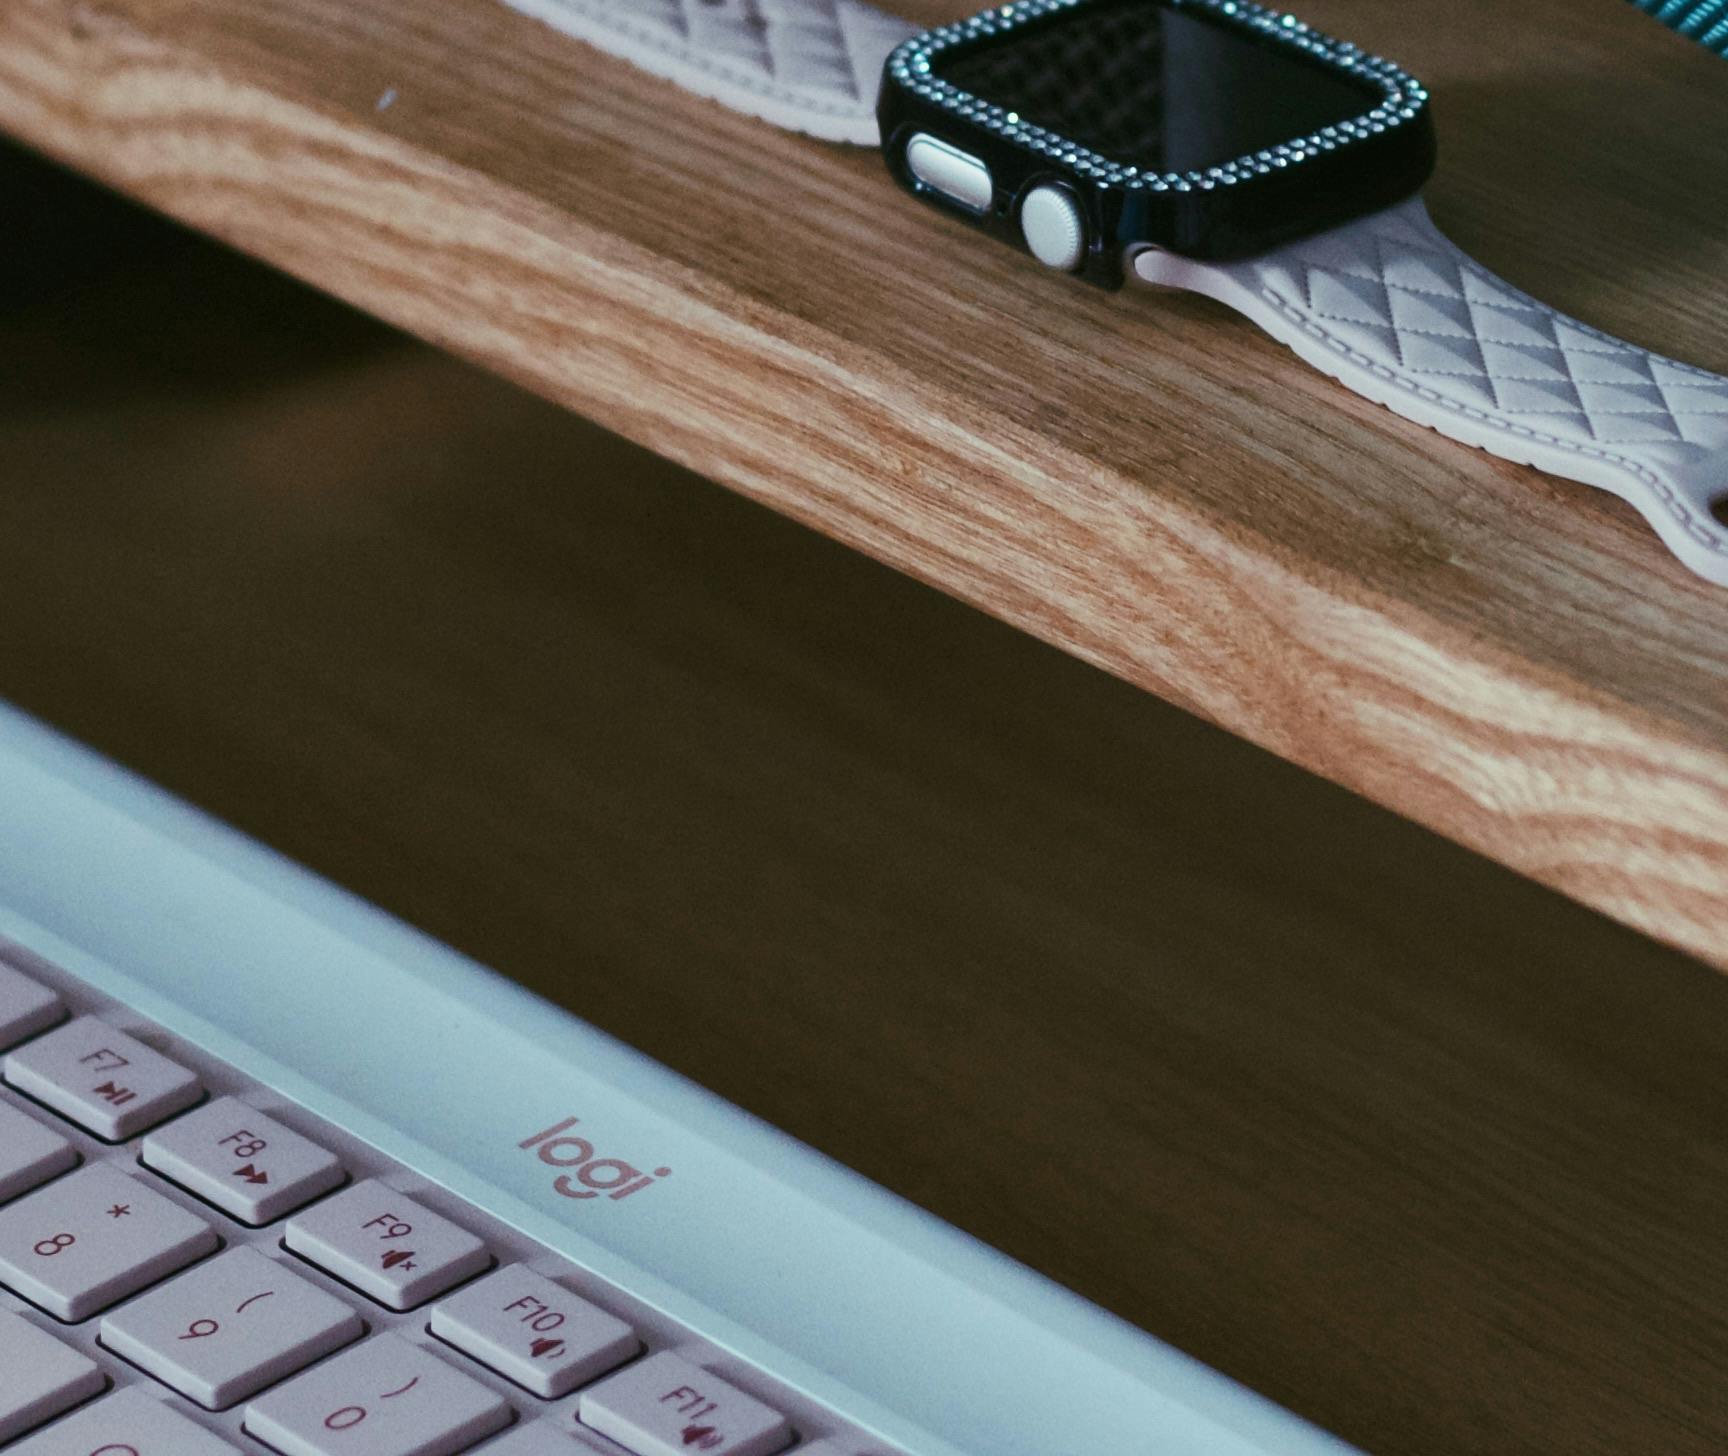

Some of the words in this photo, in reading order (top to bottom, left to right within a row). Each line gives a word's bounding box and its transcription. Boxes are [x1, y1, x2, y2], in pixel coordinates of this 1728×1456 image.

[78, 1046, 130, 1073] F7
[217, 1128, 268, 1159] F8
[516, 1116, 672, 1202] logi
[362, 1212, 414, 1240] F9
[33, 1232, 76, 1257] 8
[503, 1294, 566, 1333] F10
[178, 1318, 220, 1341] 9
[658, 1384, 719, 1420] F11
